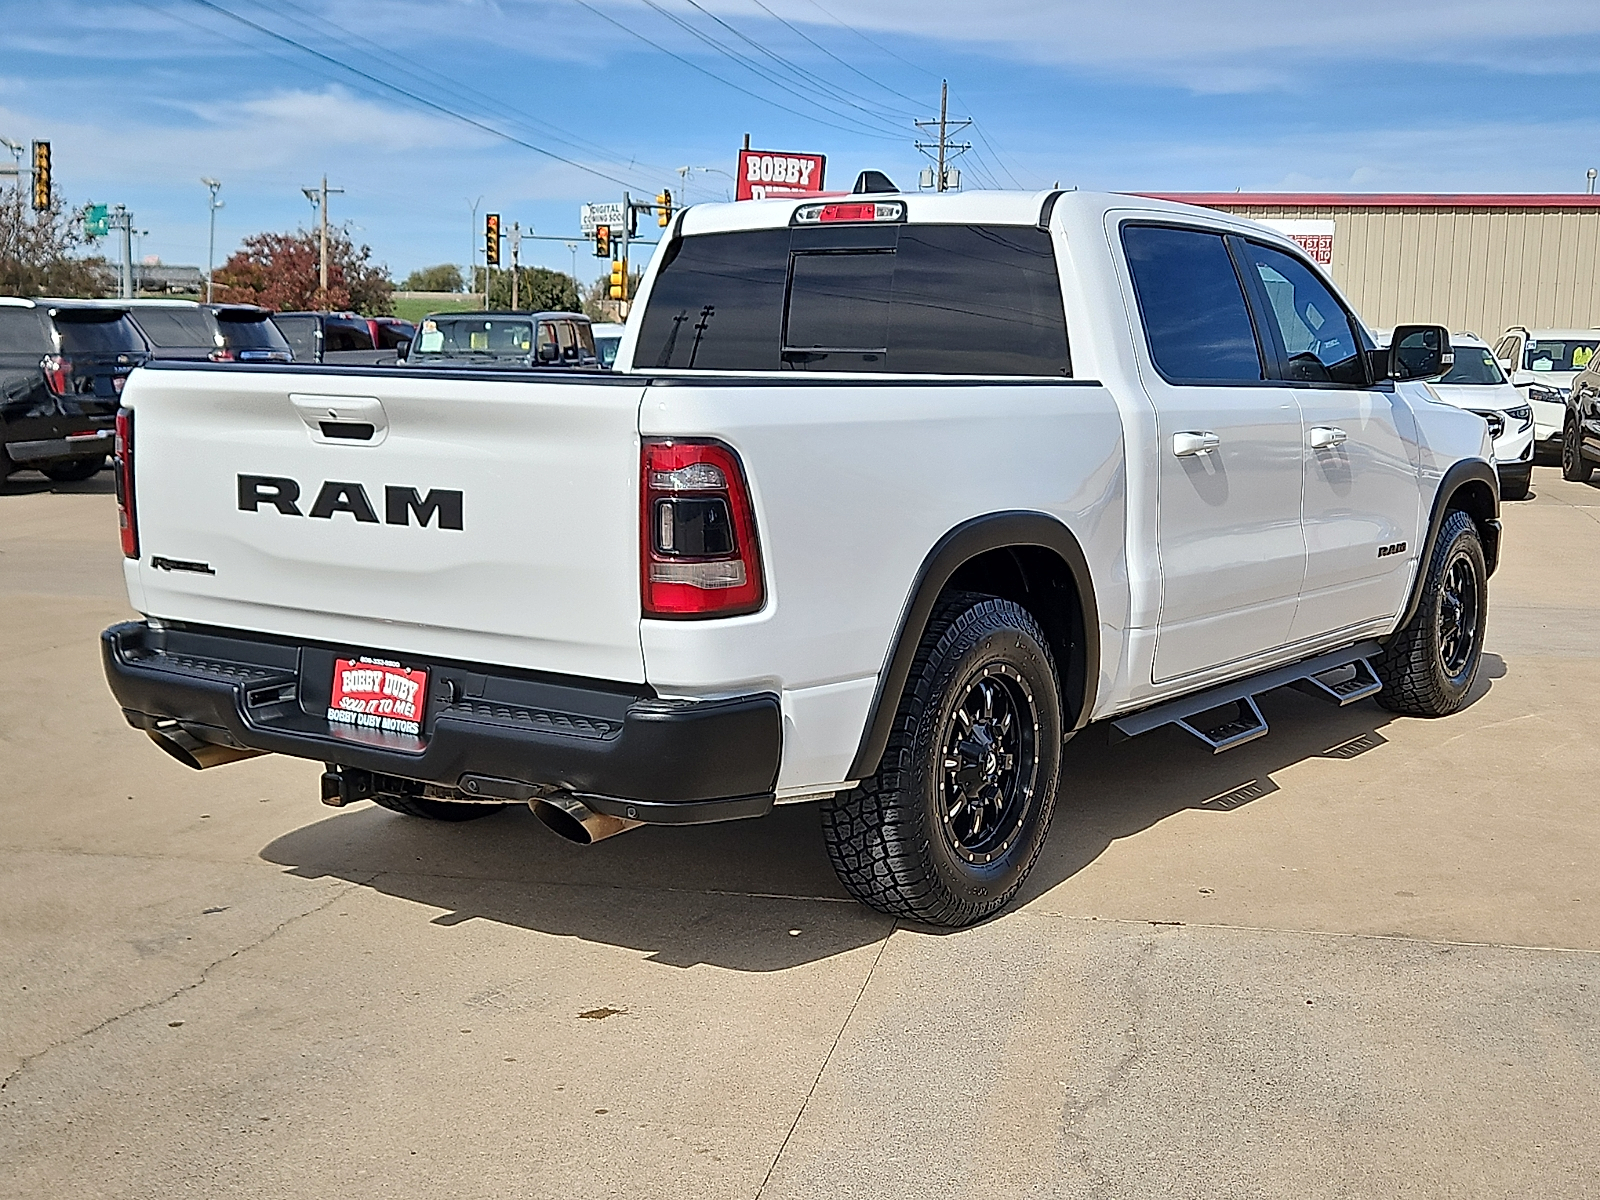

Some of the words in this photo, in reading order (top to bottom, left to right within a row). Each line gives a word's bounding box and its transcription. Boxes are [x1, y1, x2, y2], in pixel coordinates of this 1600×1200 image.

[746, 156, 815, 185] BOBBY
[590, 204, 620, 214] DIGITAL
[1320, 251, 1331, 260] 10
[237, 473, 464, 531] RAM
[1377, 542, 1407, 558] RAM
[341, 669, 384, 693] BOBBY
[382, 671, 420, 703] DUBY
[338, 696, 366, 713] SOLD
[365, 699, 380, 714] IT
[378, 699, 393, 714] TO
[393, 699, 416, 718] ME!
[327, 708, 358, 724] BOBBY
[356, 713, 382, 728] DUBY
[381, 718, 420, 735] MOTORS
